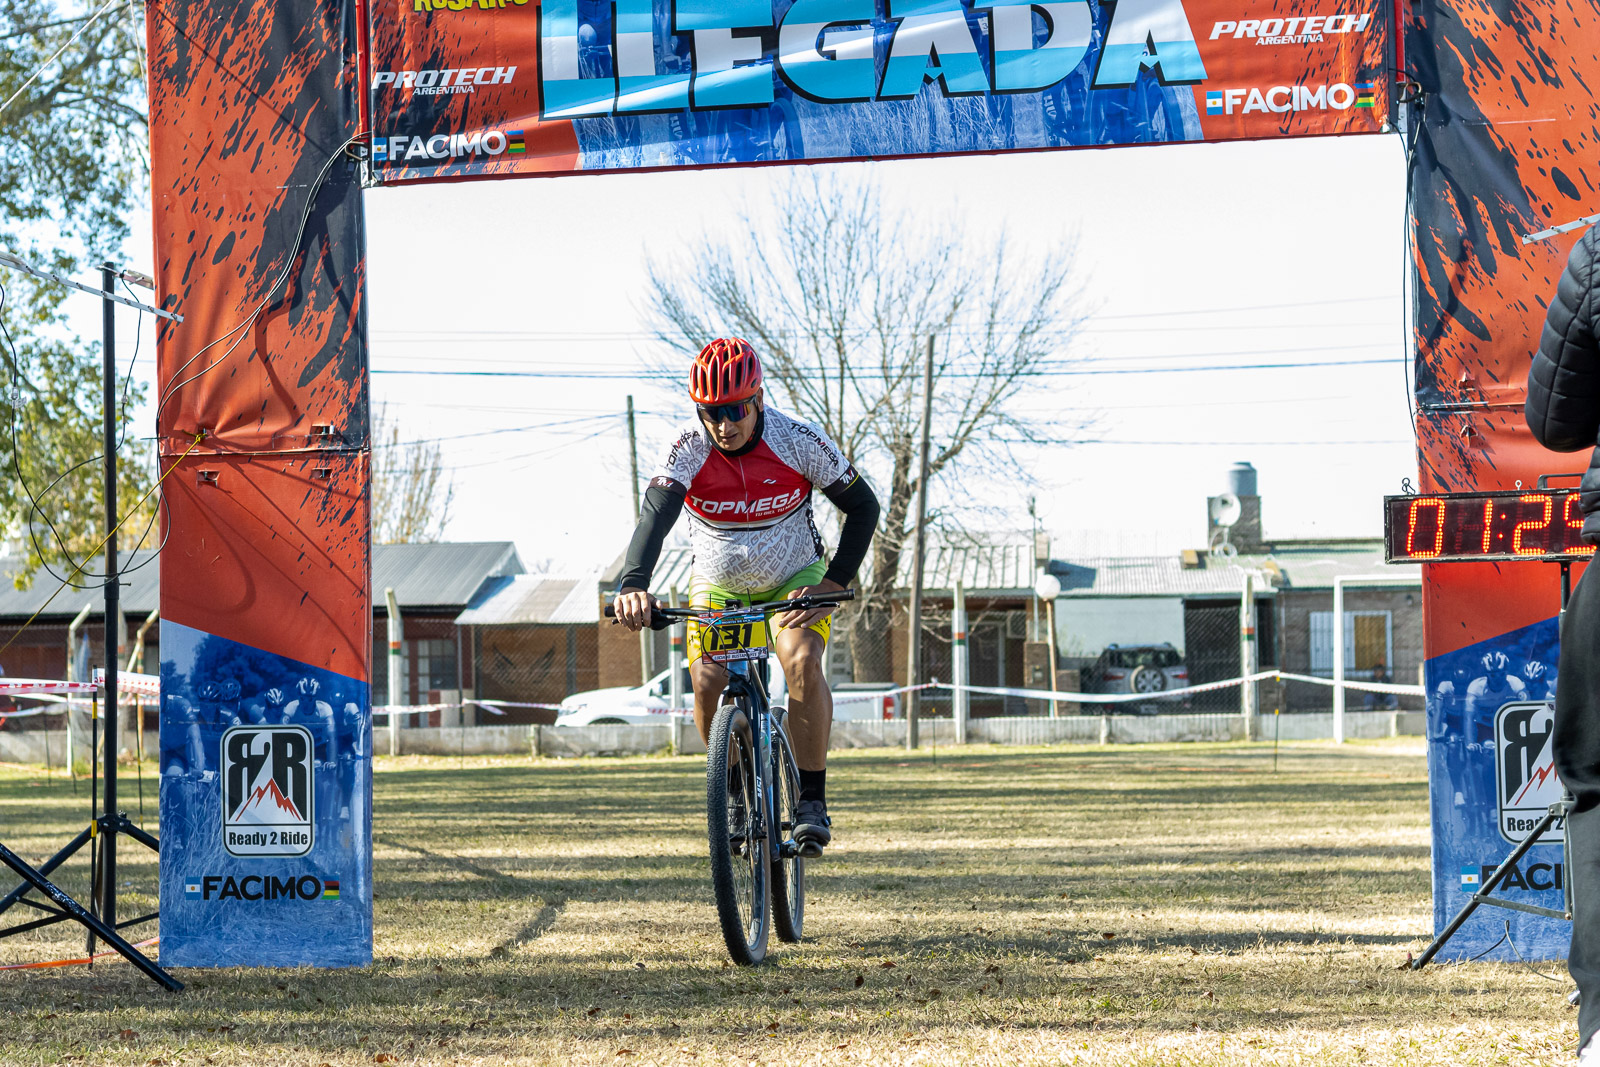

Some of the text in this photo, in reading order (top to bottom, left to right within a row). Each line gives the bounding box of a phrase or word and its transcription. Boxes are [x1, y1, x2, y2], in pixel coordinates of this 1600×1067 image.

[1208, 13, 1371, 40] PROTECH
[1255, 34, 1324, 46] ARGENTINA
[370, 66, 518, 90] PROTECH
[412, 85, 475, 96] ARGENTINA
[1224, 82, 1355, 115] FACIMO
[389, 130, 507, 161] FACIMO
[790, 422, 839, 467] TOPMEGA
[690, 488, 801, 514] TOPMEGA
[709, 624, 753, 651] 131
[229, 831, 308, 847] Ready 2 Ride
[203, 875, 322, 901] FACIMO
[1481, 863, 1565, 892] FACI
